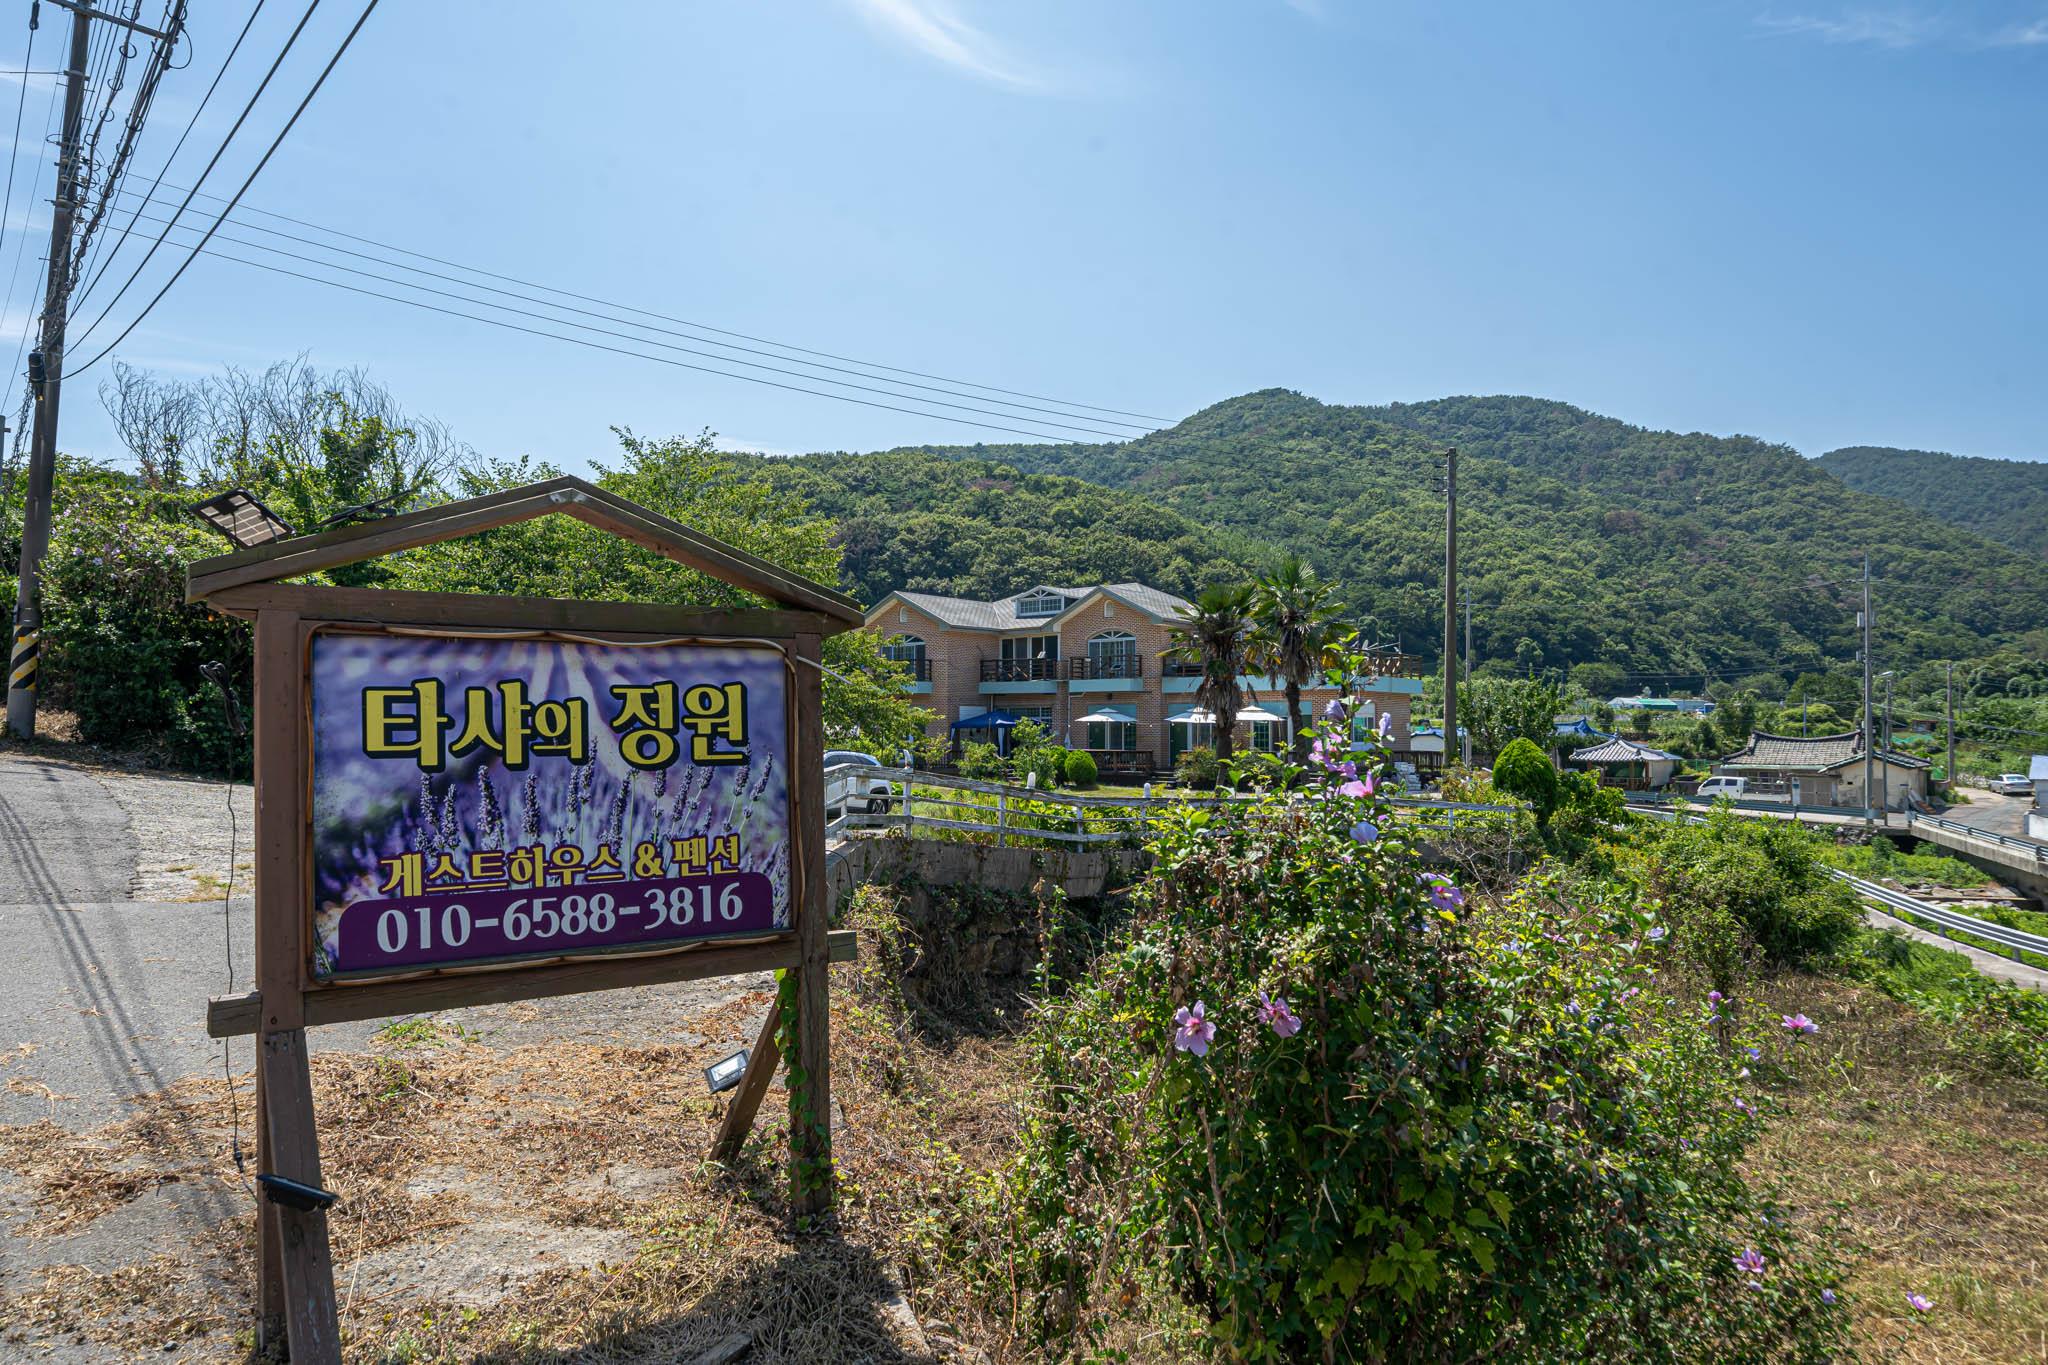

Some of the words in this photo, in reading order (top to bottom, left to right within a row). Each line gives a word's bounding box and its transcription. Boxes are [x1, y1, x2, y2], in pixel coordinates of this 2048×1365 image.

[363, 678, 588, 771] 타샤의
[611, 680, 749, 770] 정원
[379, 847, 625, 897] 게스트하우스
[634, 842, 665, 878] &
[672, 834, 740, 877] 펜션
[376, 882, 743, 953] 010-6588-3816
